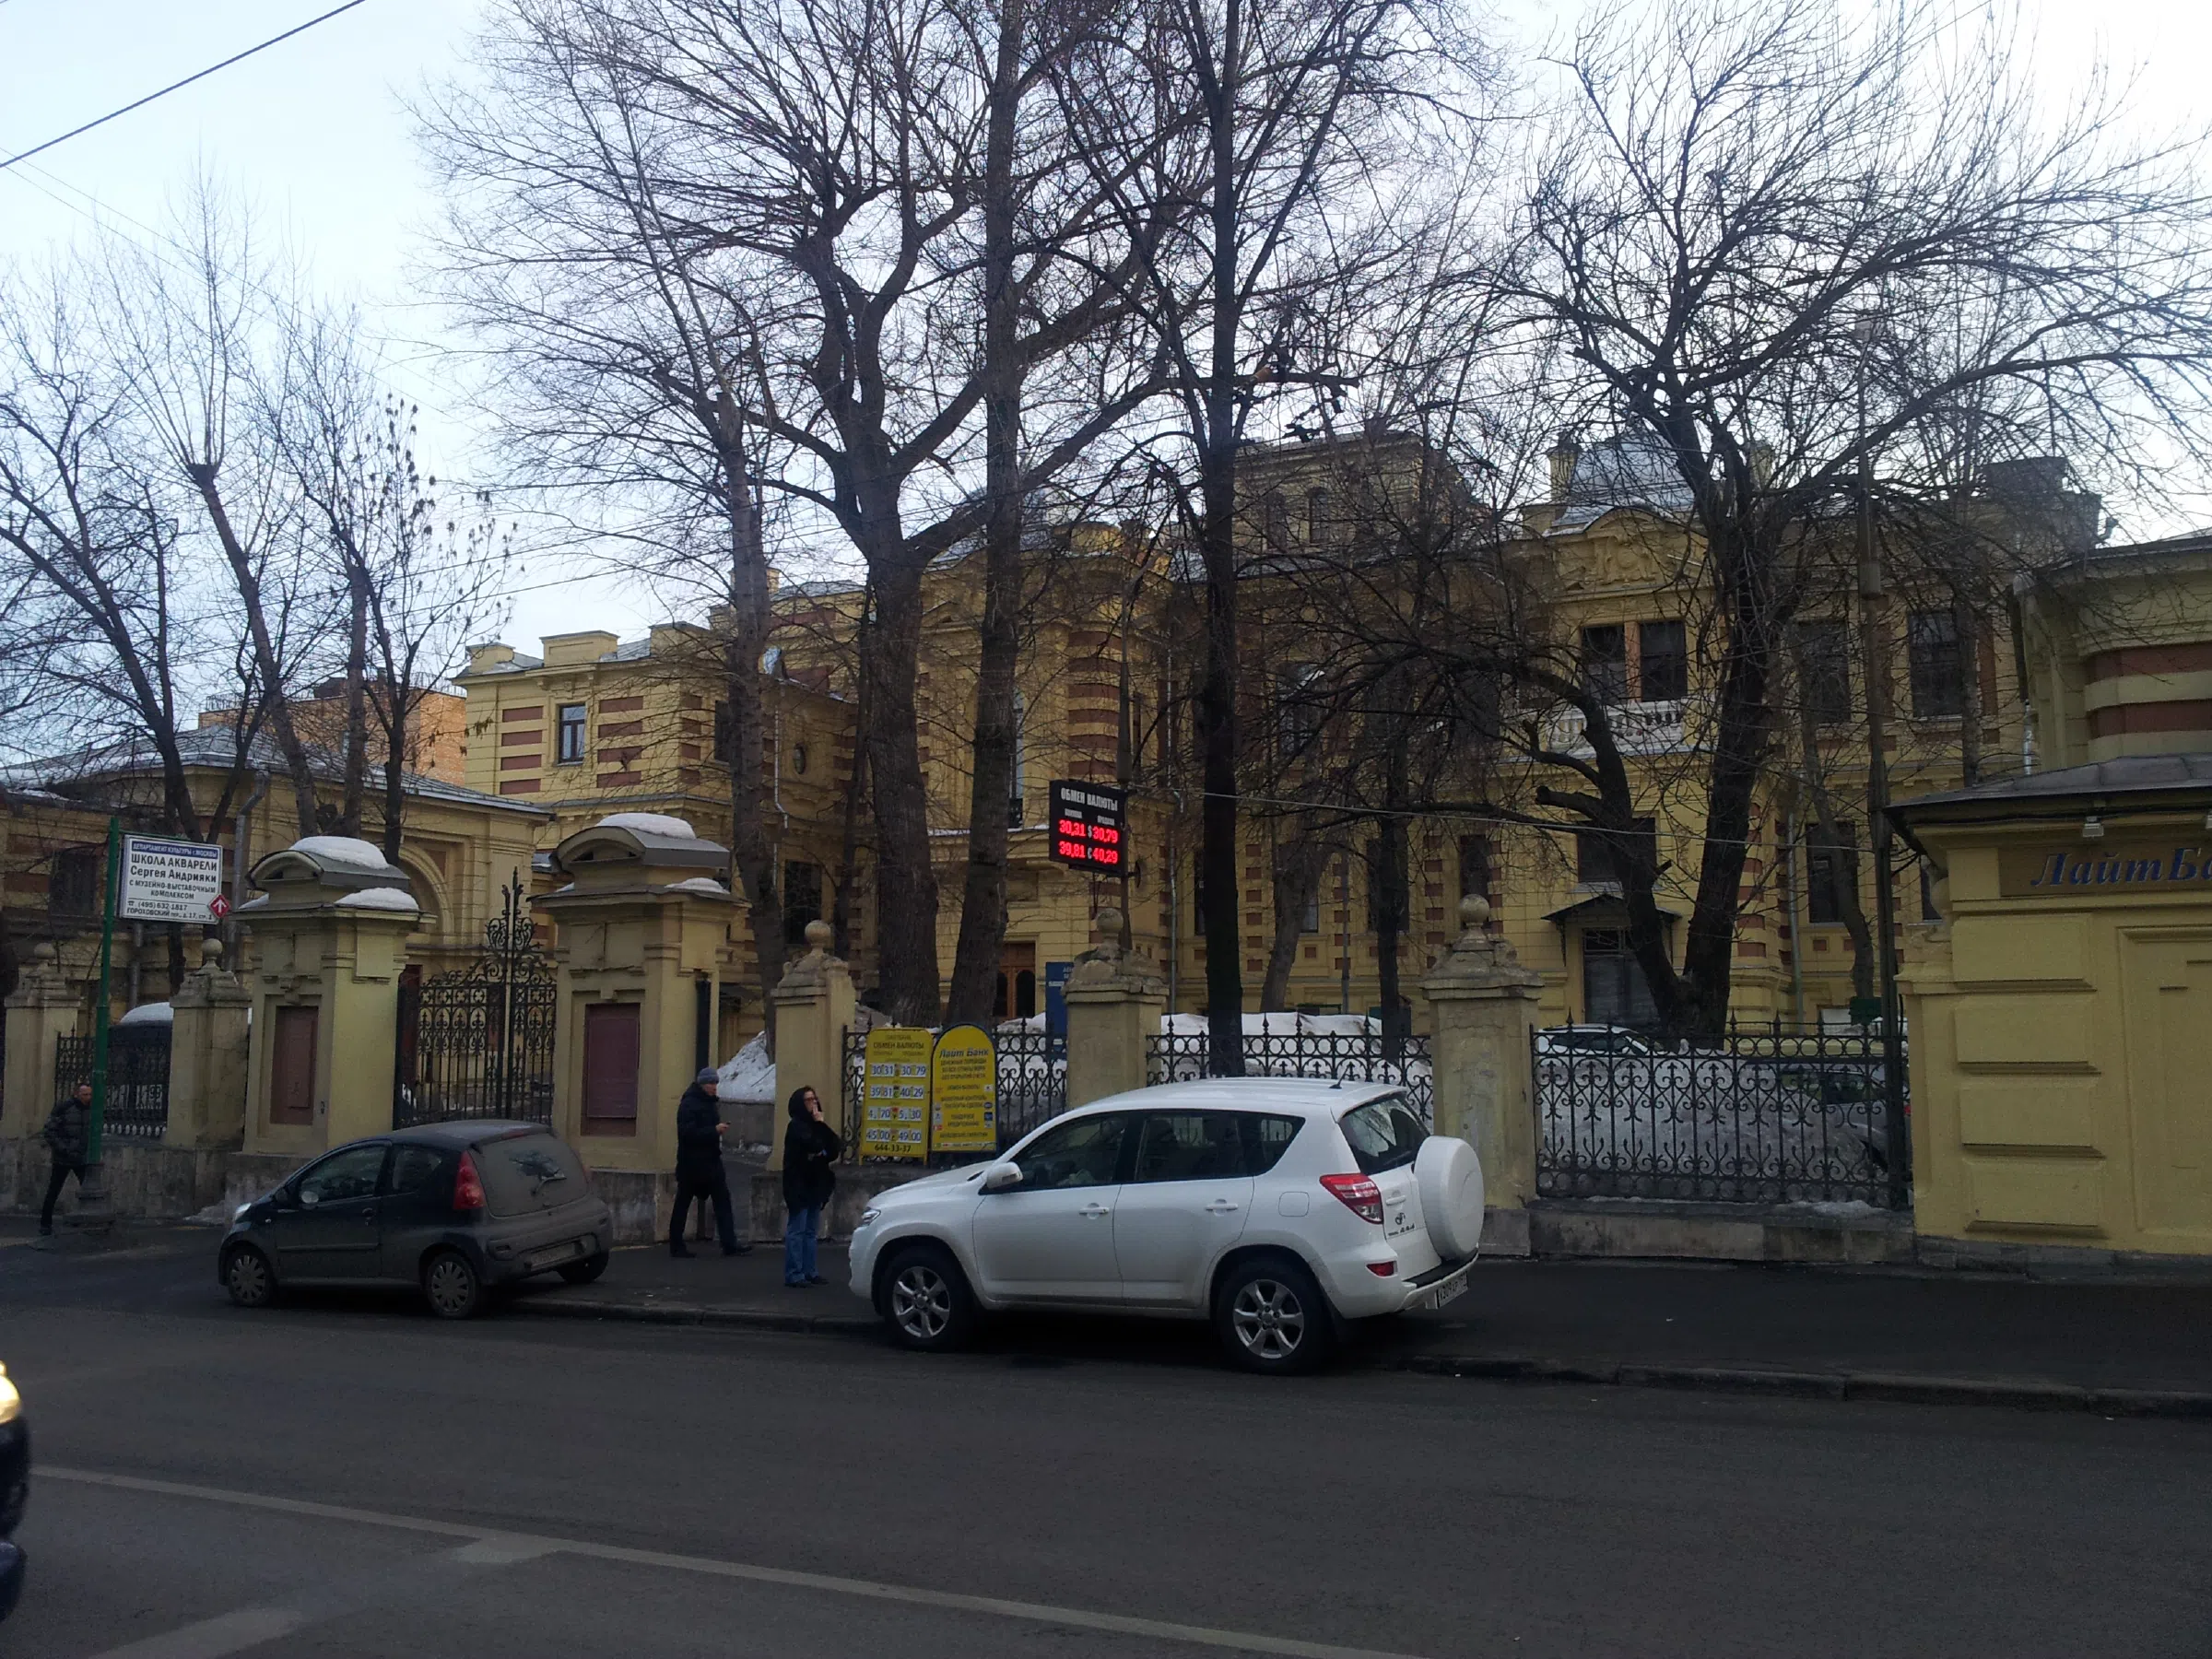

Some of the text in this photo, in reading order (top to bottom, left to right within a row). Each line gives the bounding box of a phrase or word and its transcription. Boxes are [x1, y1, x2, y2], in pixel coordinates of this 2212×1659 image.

[1061, 787, 1118, 811] ОБМЕН ВАЛЮТЫ
[133, 843, 167, 852] ДЕПАРТАМЕНТ
[131, 854, 217, 871] ШКОЛА АКВАРЕЛИ
[131, 866, 216, 882] Сергея Андрияки
[940, 1048, 989, 1058] Лайт Банк
